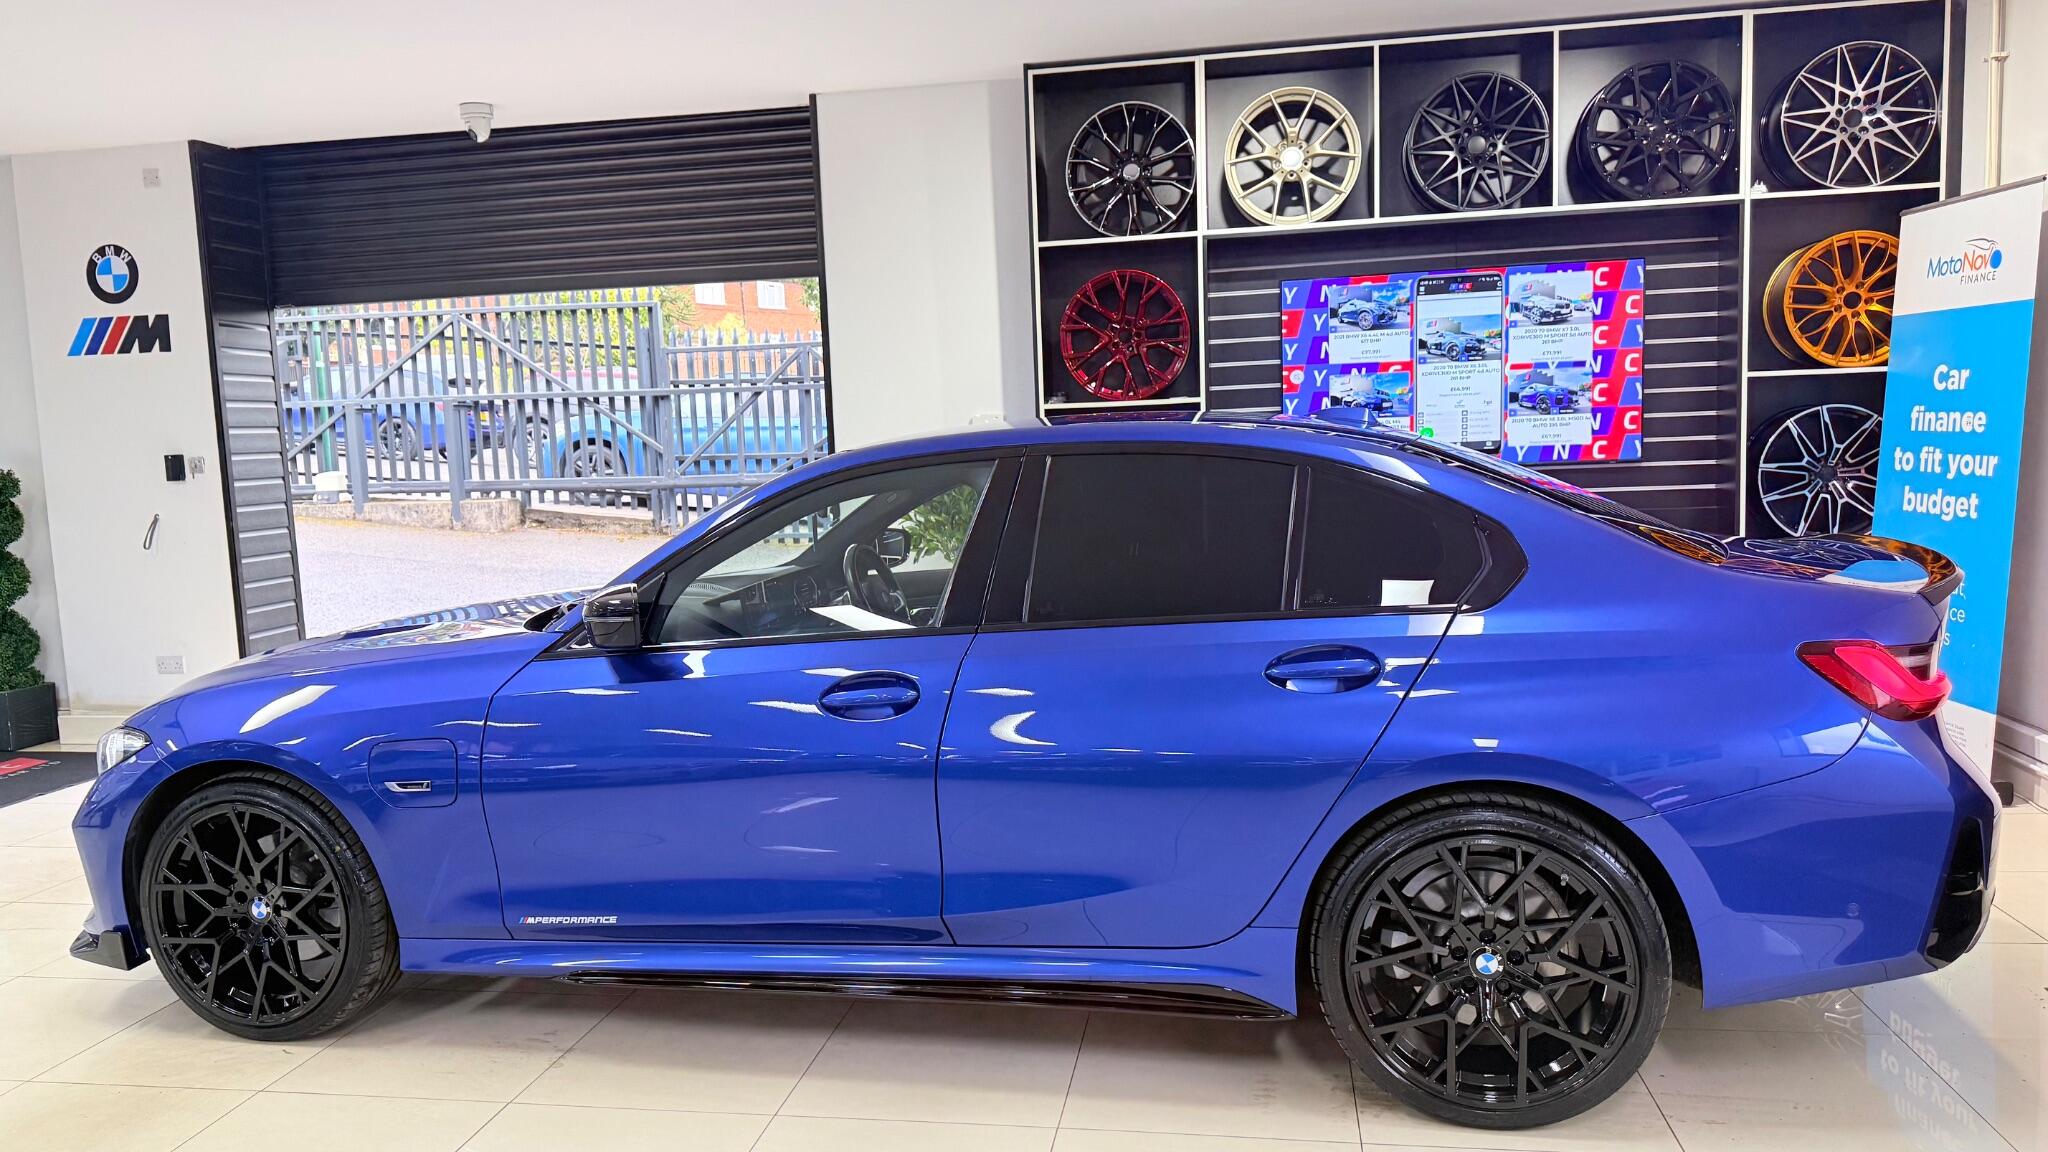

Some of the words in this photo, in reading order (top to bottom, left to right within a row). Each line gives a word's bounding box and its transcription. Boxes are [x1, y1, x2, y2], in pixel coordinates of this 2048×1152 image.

[91, 245, 132, 263] BMW
[1284, 287, 1298, 304] Y
[1594, 267, 1609, 286] C
[1960, 271, 1997, 285] FINANCE
[1313, 313, 1327, 331] Y
[1625, 295, 1640, 313] C
[1284, 343, 1298, 361] Y
[1594, 326, 1608, 344] C
[1313, 369, 1327, 386] Y
[1624, 353, 1640, 371] C
[1933, 364, 1971, 391] Car
[1285, 399, 1299, 416] Y
[1594, 383, 1608, 401] C
[1623, 411, 1639, 429] C
[1910, 405, 1987, 433] finance
[1553, 444, 1571, 460] N
[1592, 440, 1608, 459] C
[1894, 446, 1914, 472] to
[1920, 446, 1943, 473] fit
[1946, 453, 1999, 480] your
[1902, 485, 1979, 521] budget
